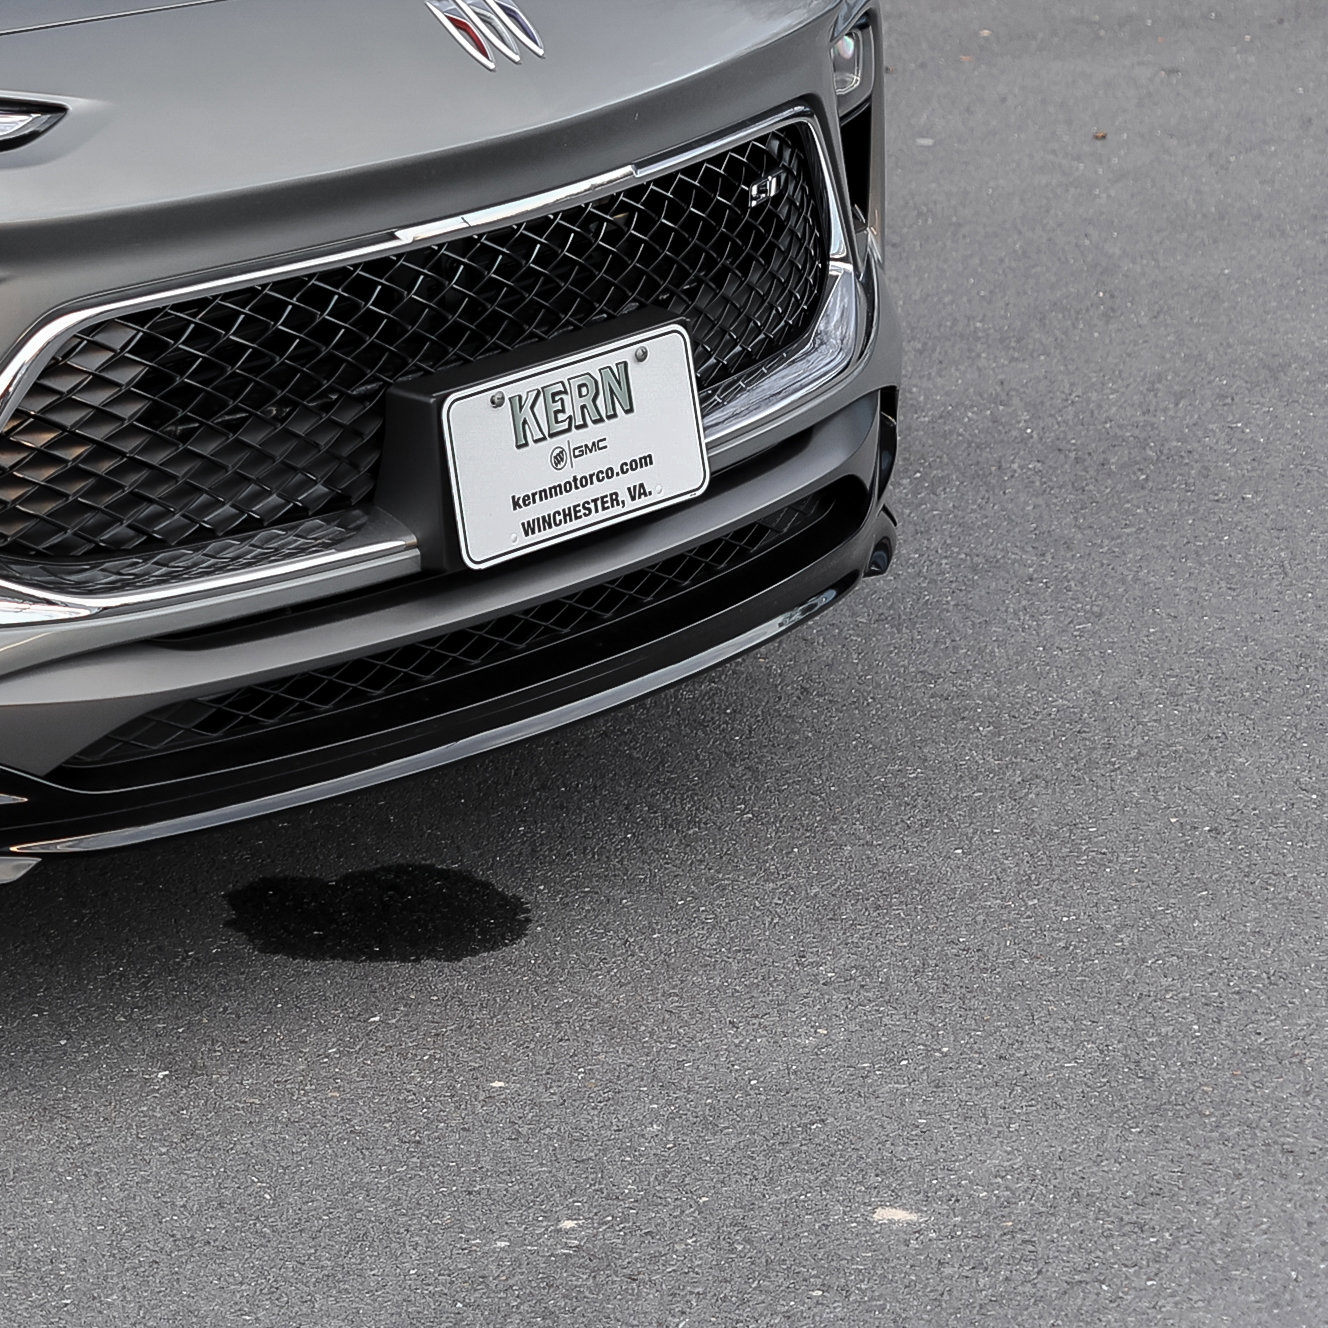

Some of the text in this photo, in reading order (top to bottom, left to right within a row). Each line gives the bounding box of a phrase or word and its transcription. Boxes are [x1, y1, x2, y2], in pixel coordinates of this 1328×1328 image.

[509, 361, 634, 449] KERN
[572, 438, 608, 459] GMC
[511, 452, 654, 511] kernmotorco.com
[521, 482, 652, 538] WINCHESTER, VA.
